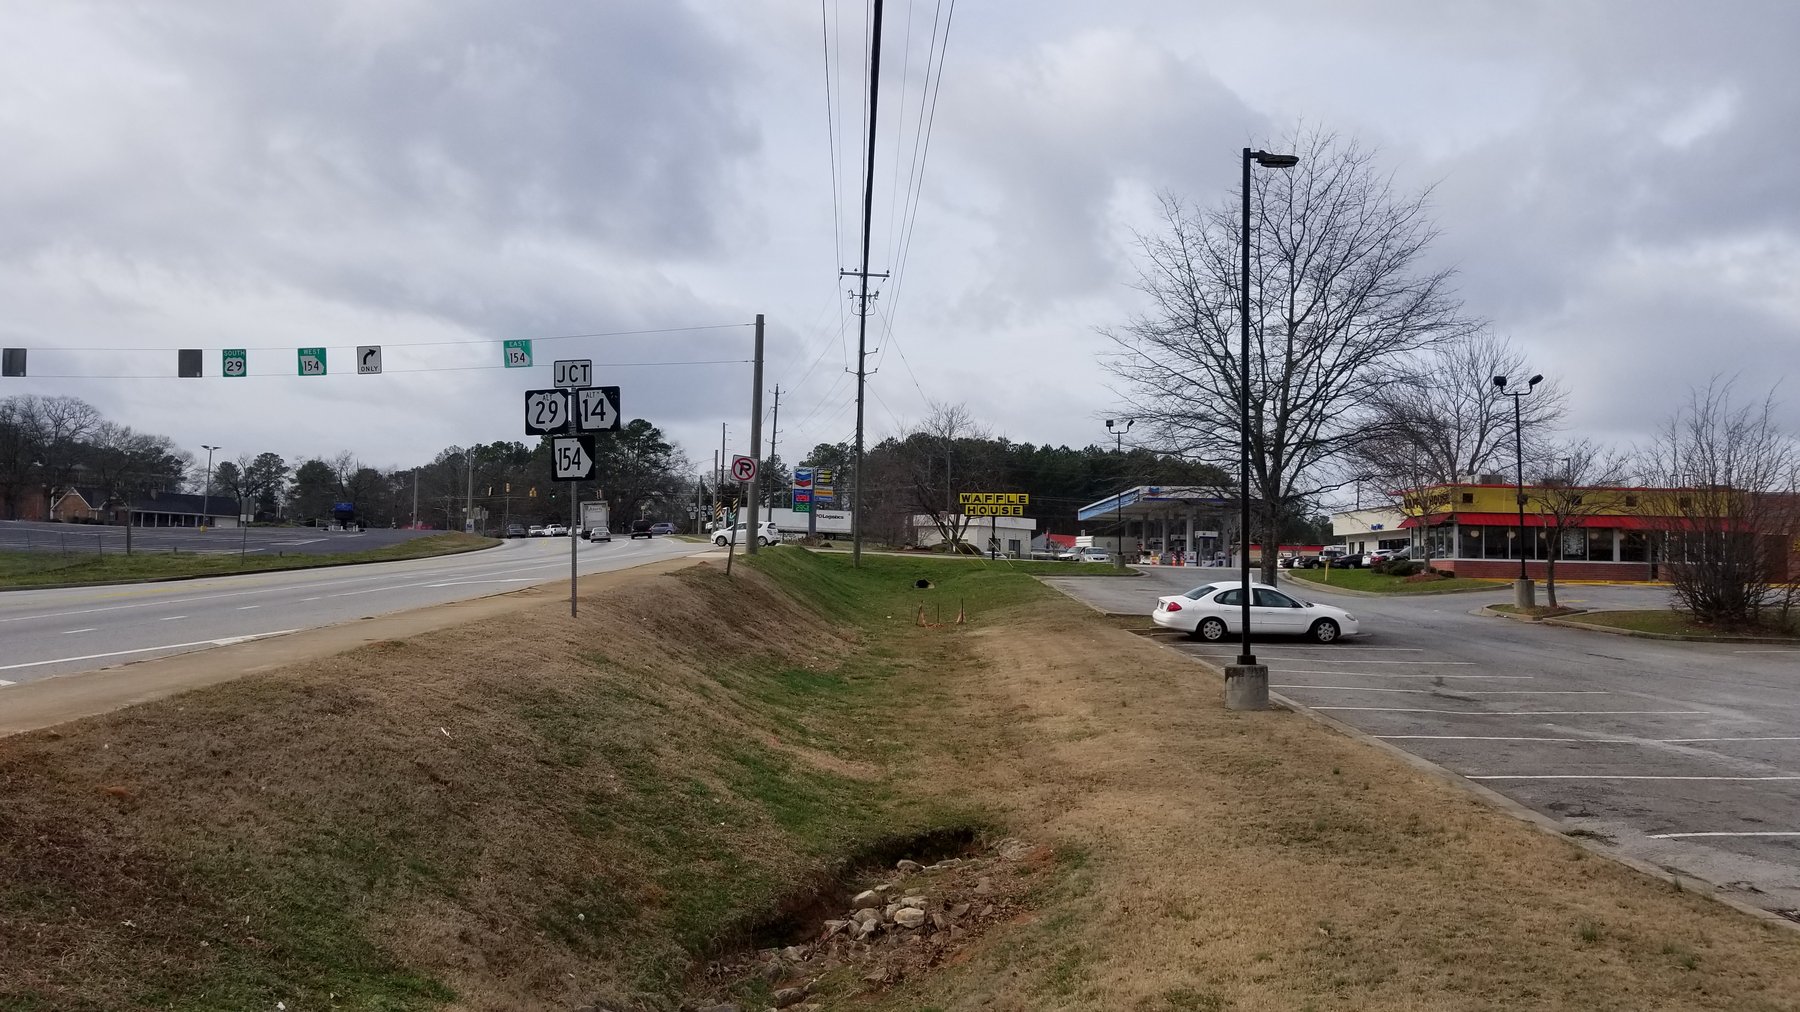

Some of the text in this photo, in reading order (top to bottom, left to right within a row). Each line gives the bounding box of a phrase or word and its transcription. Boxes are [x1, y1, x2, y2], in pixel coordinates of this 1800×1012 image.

[510, 352, 525, 363] 154
[226, 361, 243, 371] 29
[303, 360, 319, 371] 154
[556, 364, 589, 383] JCT
[585, 391, 596, 399] ALT
[535, 400, 559, 424] 29
[582, 398, 606, 422] 14
[557, 447, 581, 471] 154
[961, 494, 1027, 504] WAFFLE
[967, 506, 1021, 515] HOUSE
